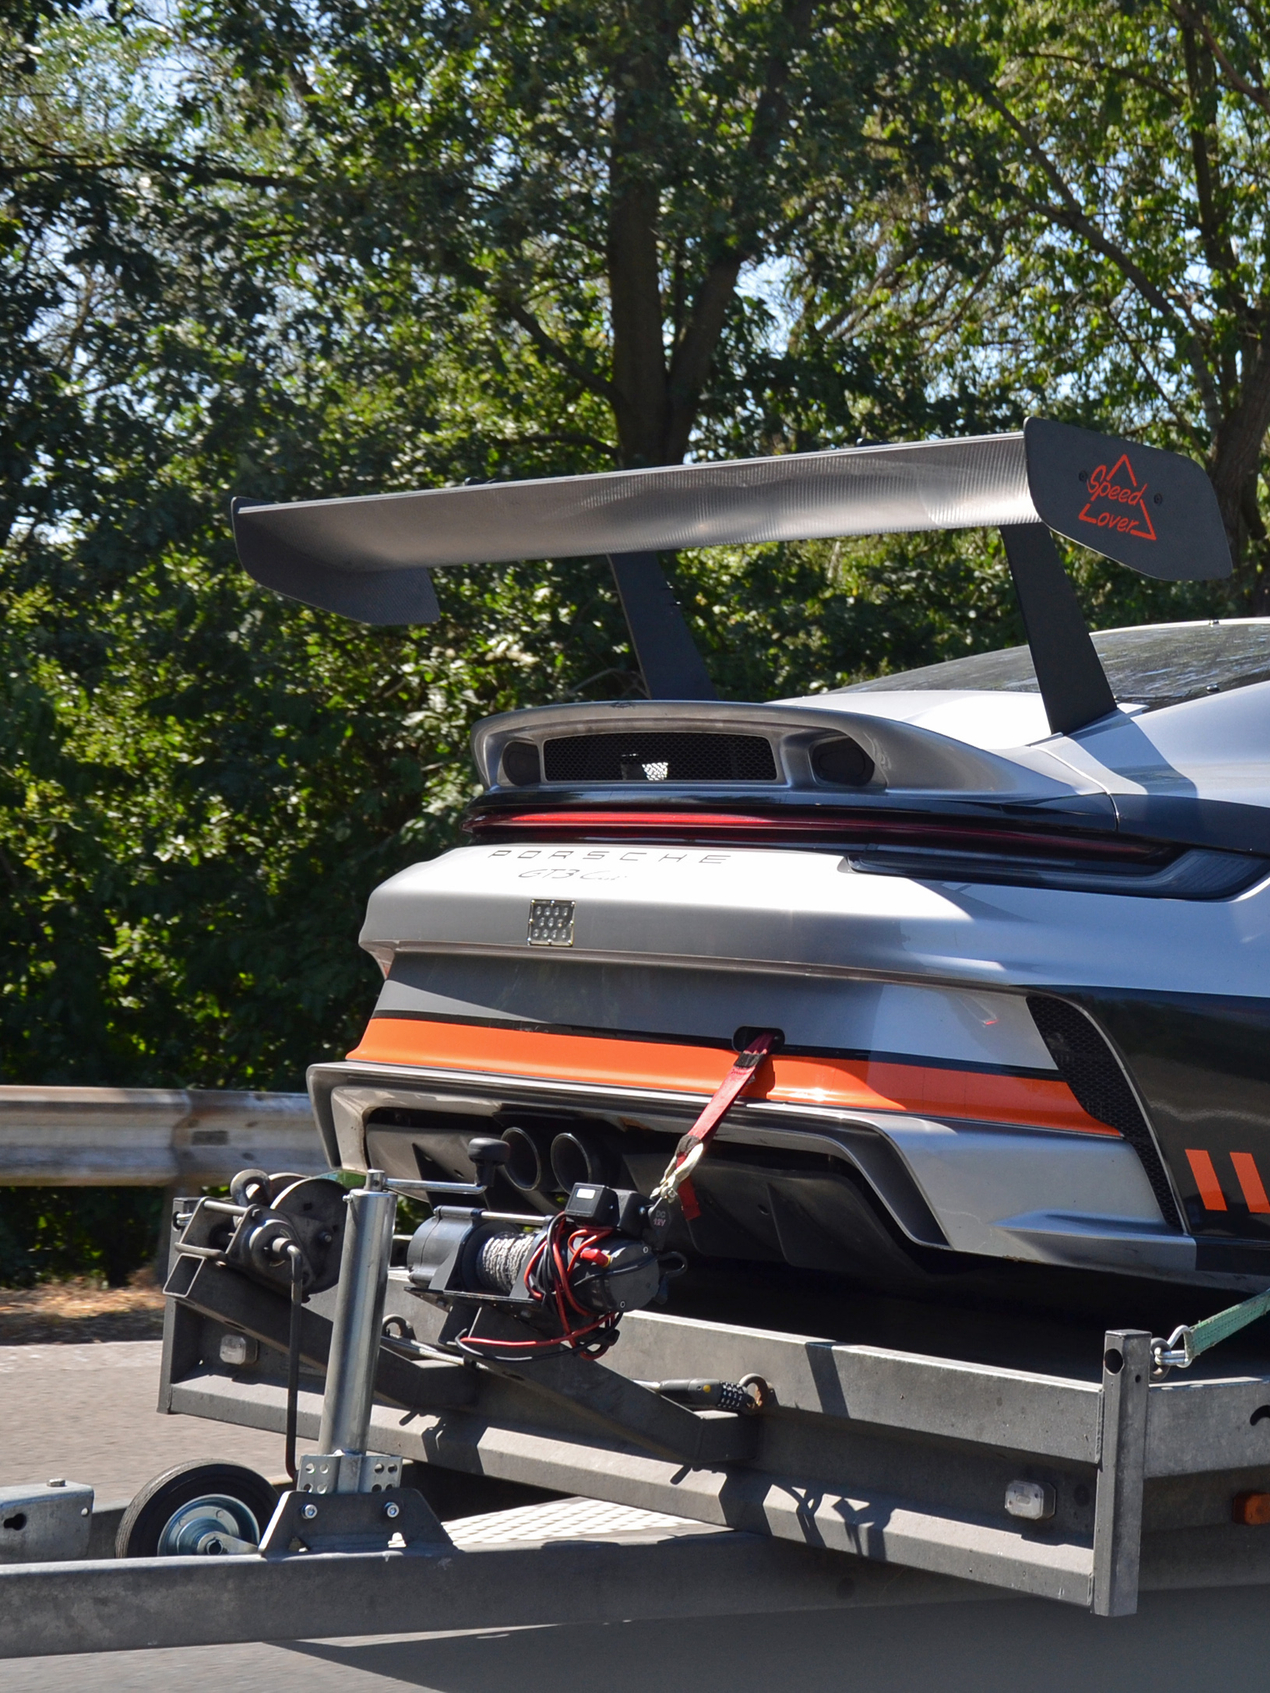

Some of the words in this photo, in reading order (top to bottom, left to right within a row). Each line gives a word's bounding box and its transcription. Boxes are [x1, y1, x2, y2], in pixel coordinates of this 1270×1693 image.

[1086, 464, 1148, 506] Speed
[1078, 503, 1140, 533] Lover
[487, 849, 732, 865] PORSCHE
[518, 868, 581, 879] GT3
